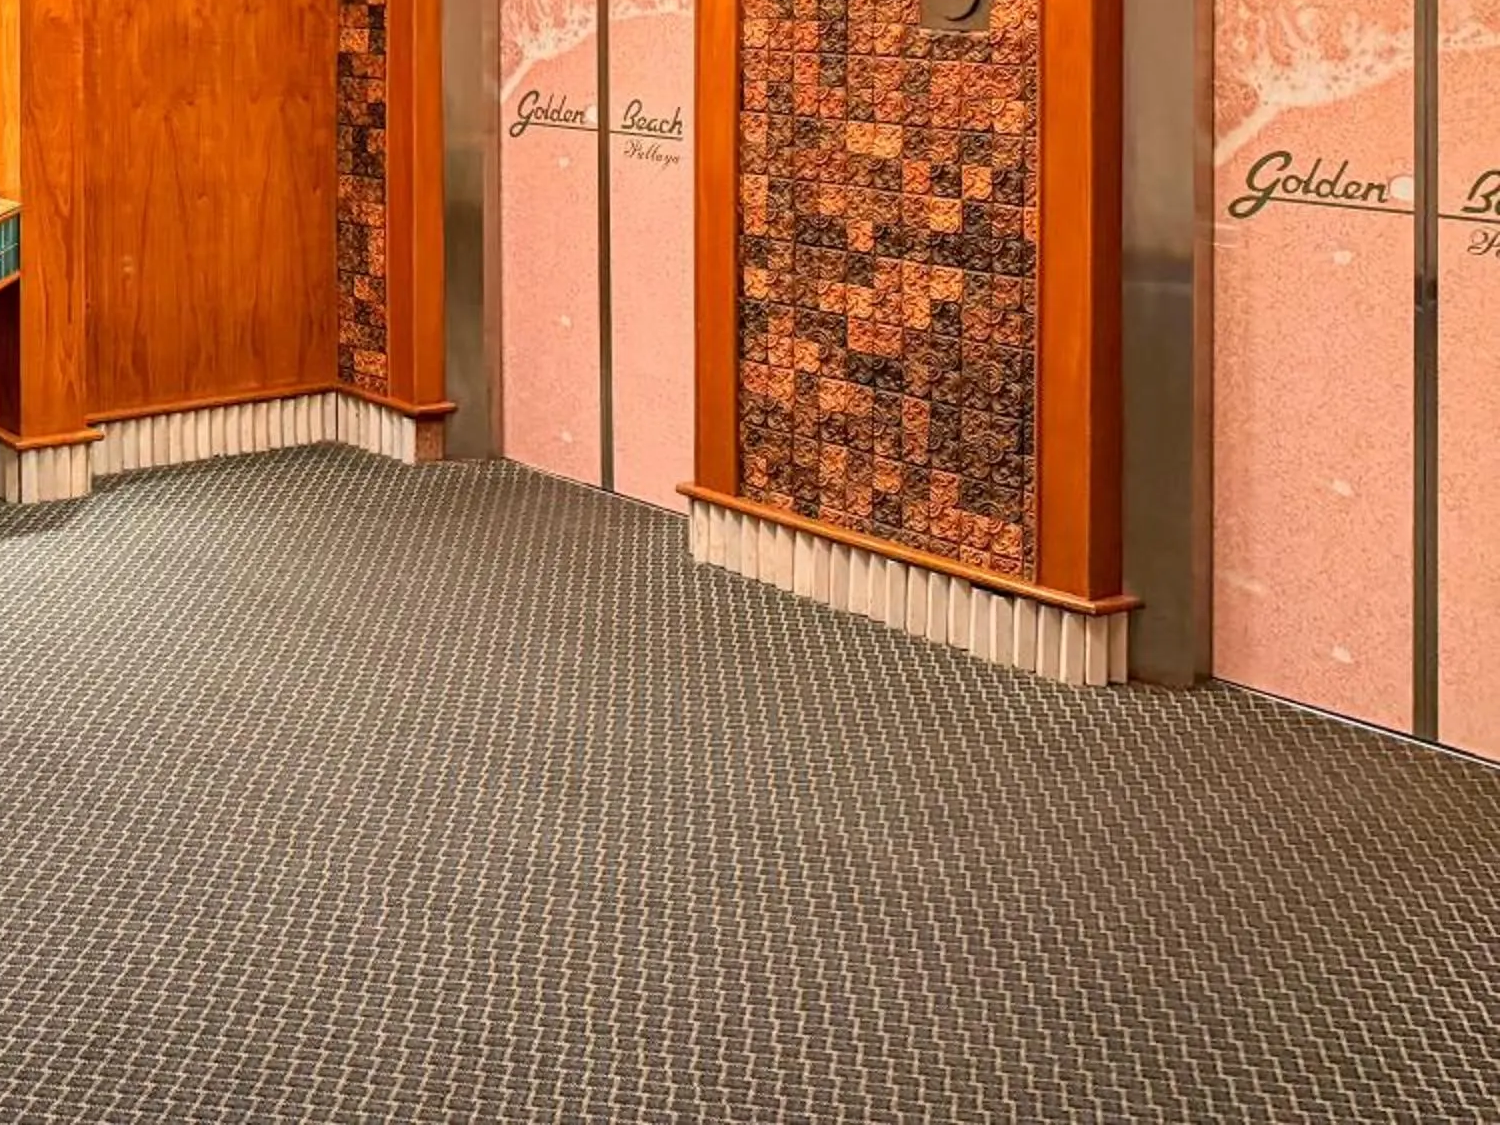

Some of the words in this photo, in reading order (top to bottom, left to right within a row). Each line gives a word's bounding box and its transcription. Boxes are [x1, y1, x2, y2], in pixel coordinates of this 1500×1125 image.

[509, 90, 587, 137] Golden
[621, 99, 683, 135] Beach
[1228, 150, 1388, 219] Golden
